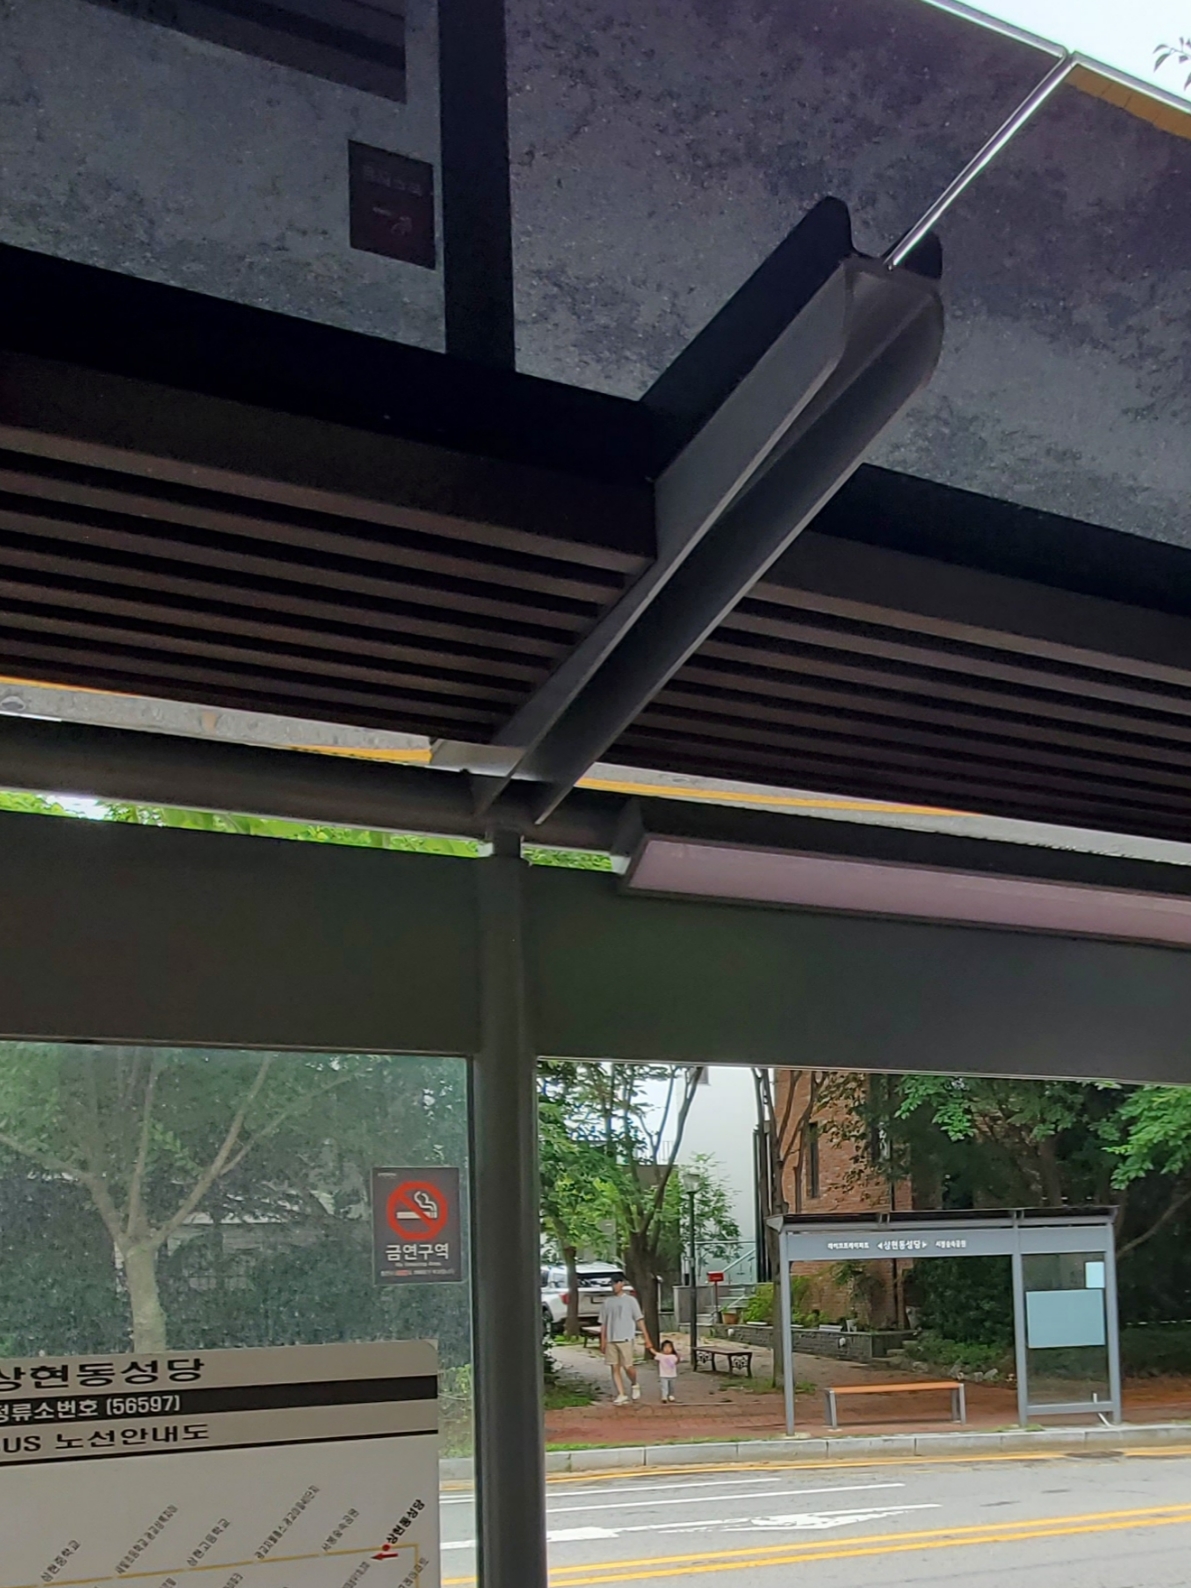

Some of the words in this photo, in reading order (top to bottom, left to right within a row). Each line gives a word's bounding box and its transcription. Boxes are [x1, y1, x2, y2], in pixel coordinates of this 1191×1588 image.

[385, 1243, 449, 1261] 금연구역
[106, 1395, 181, 1415] (56597)
[55, 1424, 210, 1449] 노선안내도
[387, 1499, 426, 1544] 상현동성당
[187, 1518, 231, 1566] 상현고등학교
[40, 1540, 81, 1582] 상현중학교
